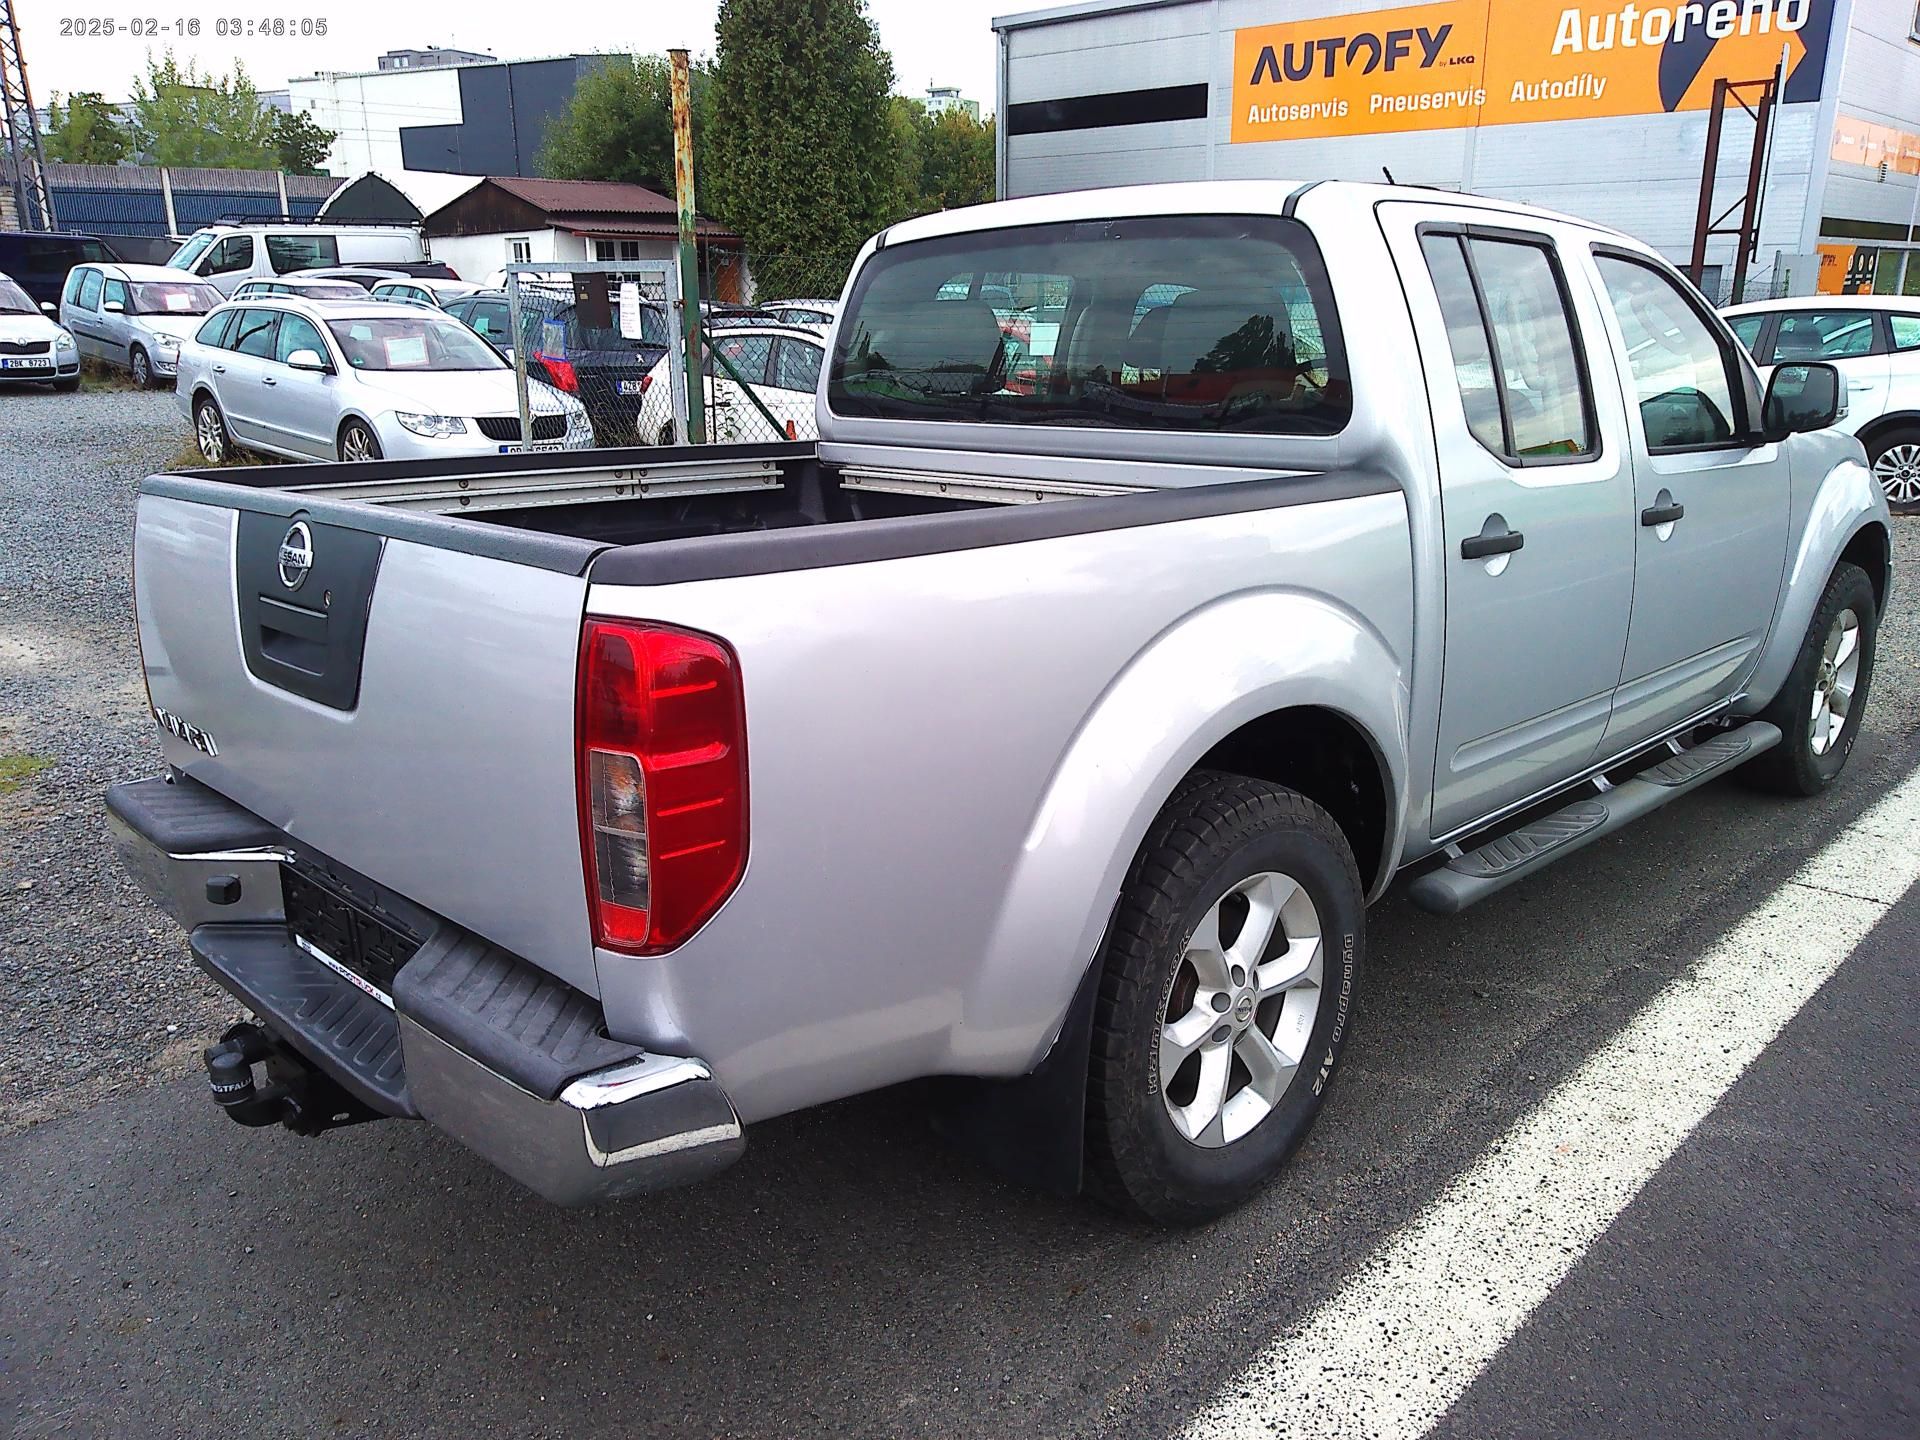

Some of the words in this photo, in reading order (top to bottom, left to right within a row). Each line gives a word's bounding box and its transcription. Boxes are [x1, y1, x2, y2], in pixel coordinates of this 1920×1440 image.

[1249, 23, 1454, 86] AUTOFY
[1449, 55, 1475, 65] LKQ
[1247, 97, 1349, 125] Autoservis
[1369, 85, 1487, 115] Pneuservis
[1510, 73, 1608, 104] Autodíly
